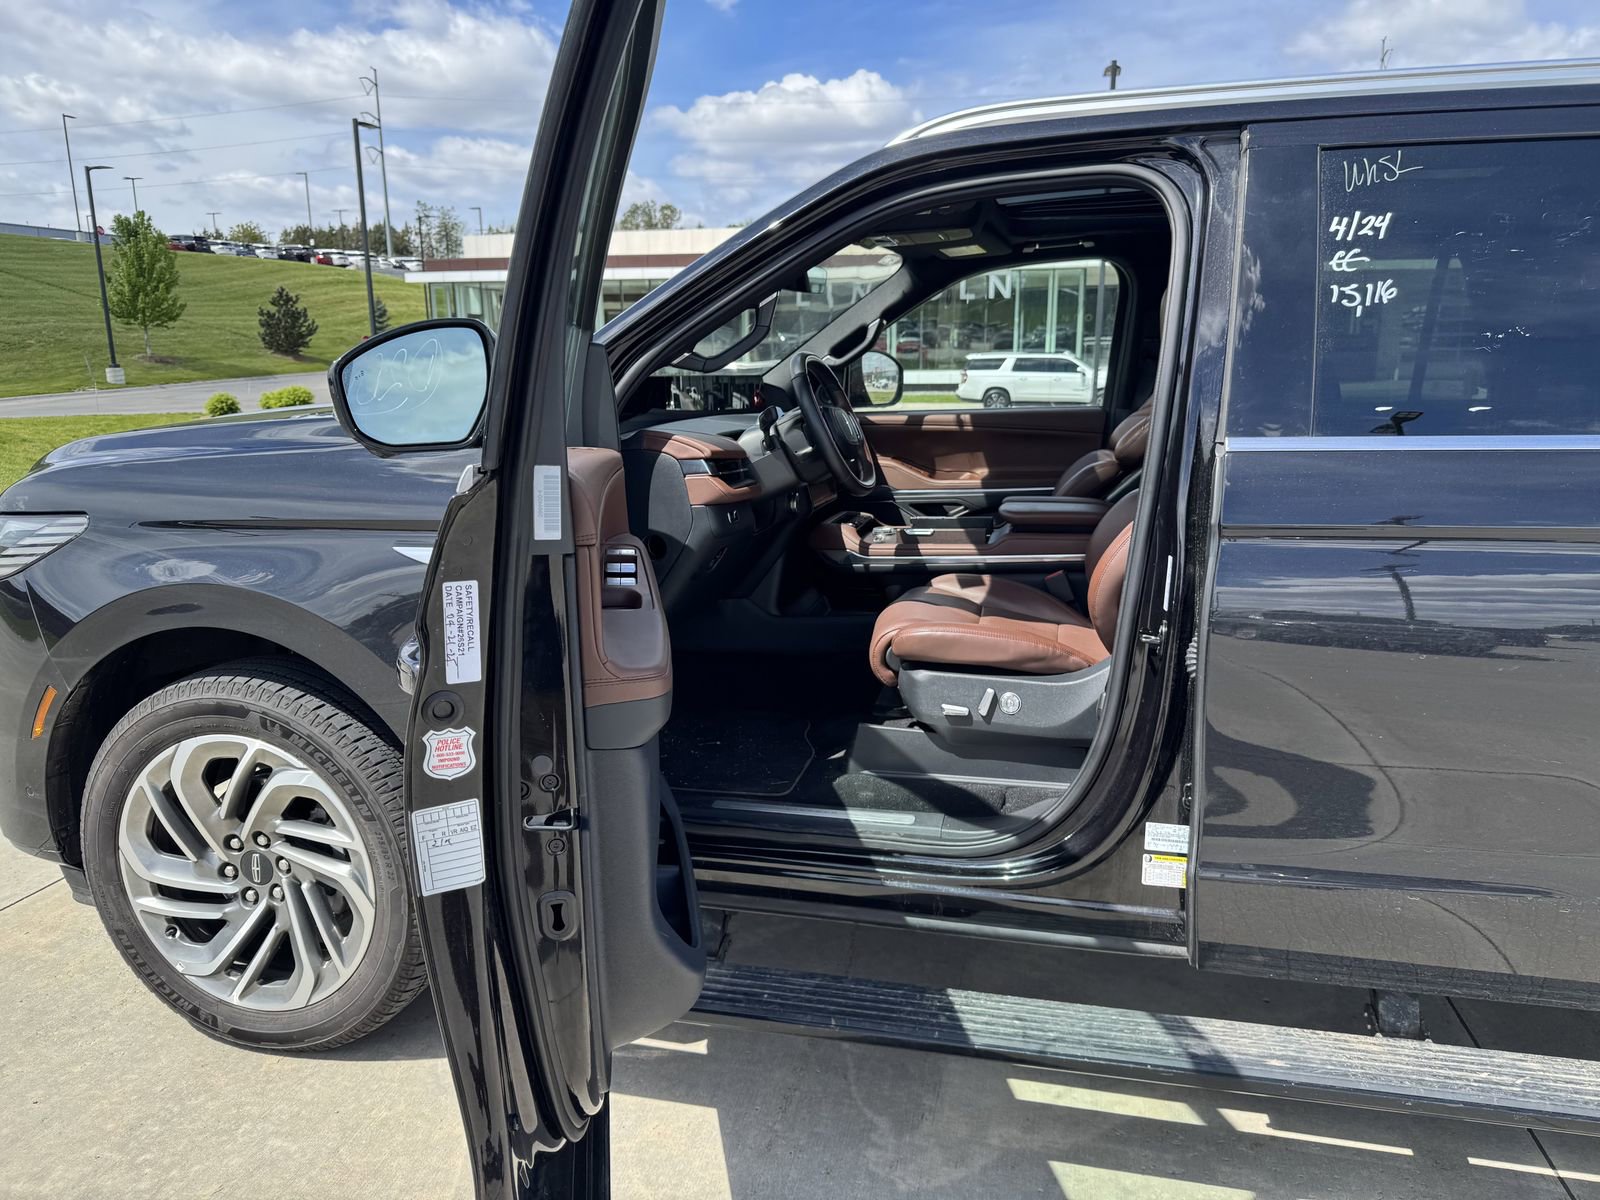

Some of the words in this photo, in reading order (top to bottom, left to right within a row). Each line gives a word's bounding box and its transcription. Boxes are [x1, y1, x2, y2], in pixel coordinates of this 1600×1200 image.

[1328, 210, 1393, 241] 4/24
[1329, 279, 1398, 318] 15,116
[445, 585, 454, 608] DATE
[464, 584, 475, 652] SAFETY/RECALL
[434, 743, 463, 752] HOTLINE
[437, 737, 461, 746] POLICE
[288, 735, 375, 821] MICHELIN
[117, 933, 193, 1011] MICHELIN
